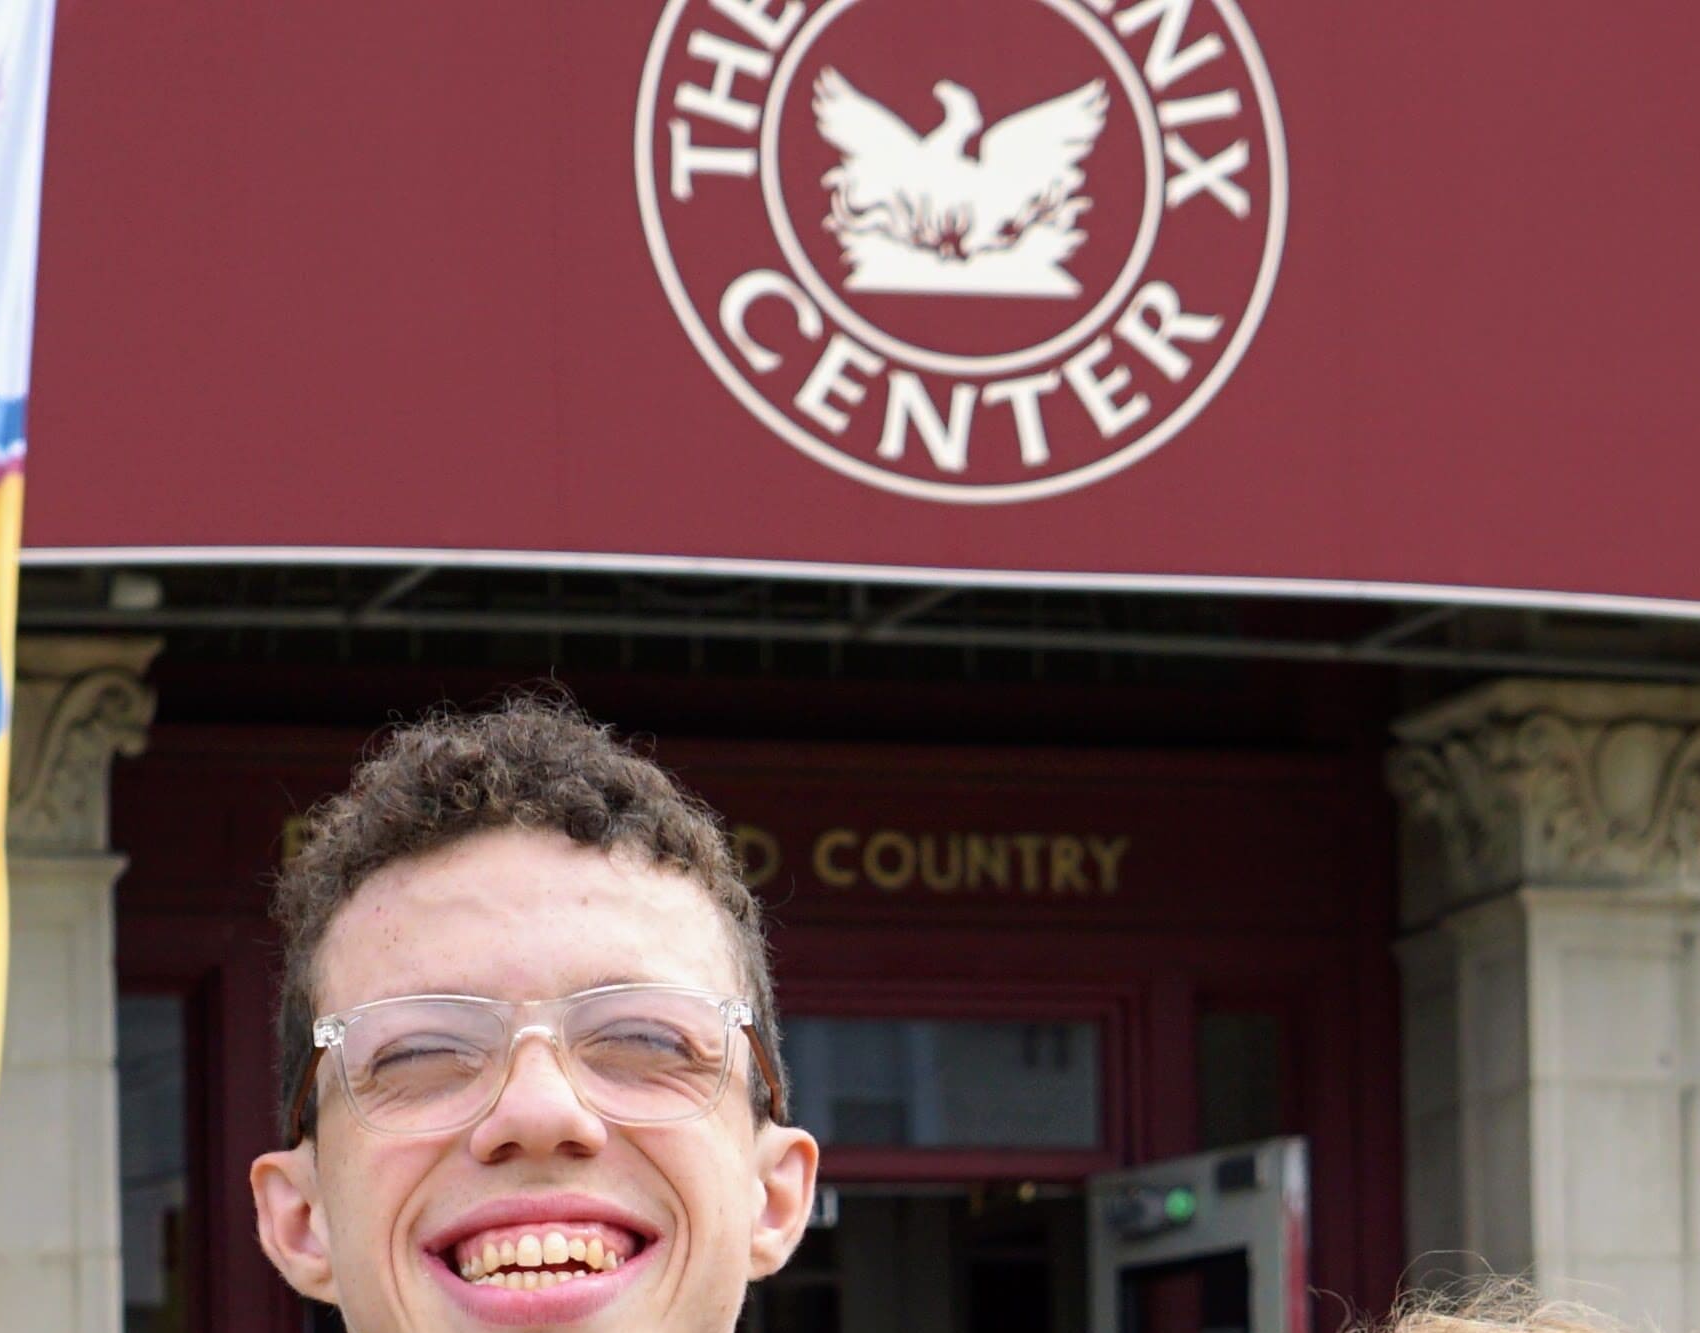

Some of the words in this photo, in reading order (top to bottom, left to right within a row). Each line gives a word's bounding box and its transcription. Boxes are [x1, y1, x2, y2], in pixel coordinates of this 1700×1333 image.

[668, 0, 806, 203] THE
[719, 267, 1224, 472] CENTER
[811, 828, 1132, 895] COUNTRY
